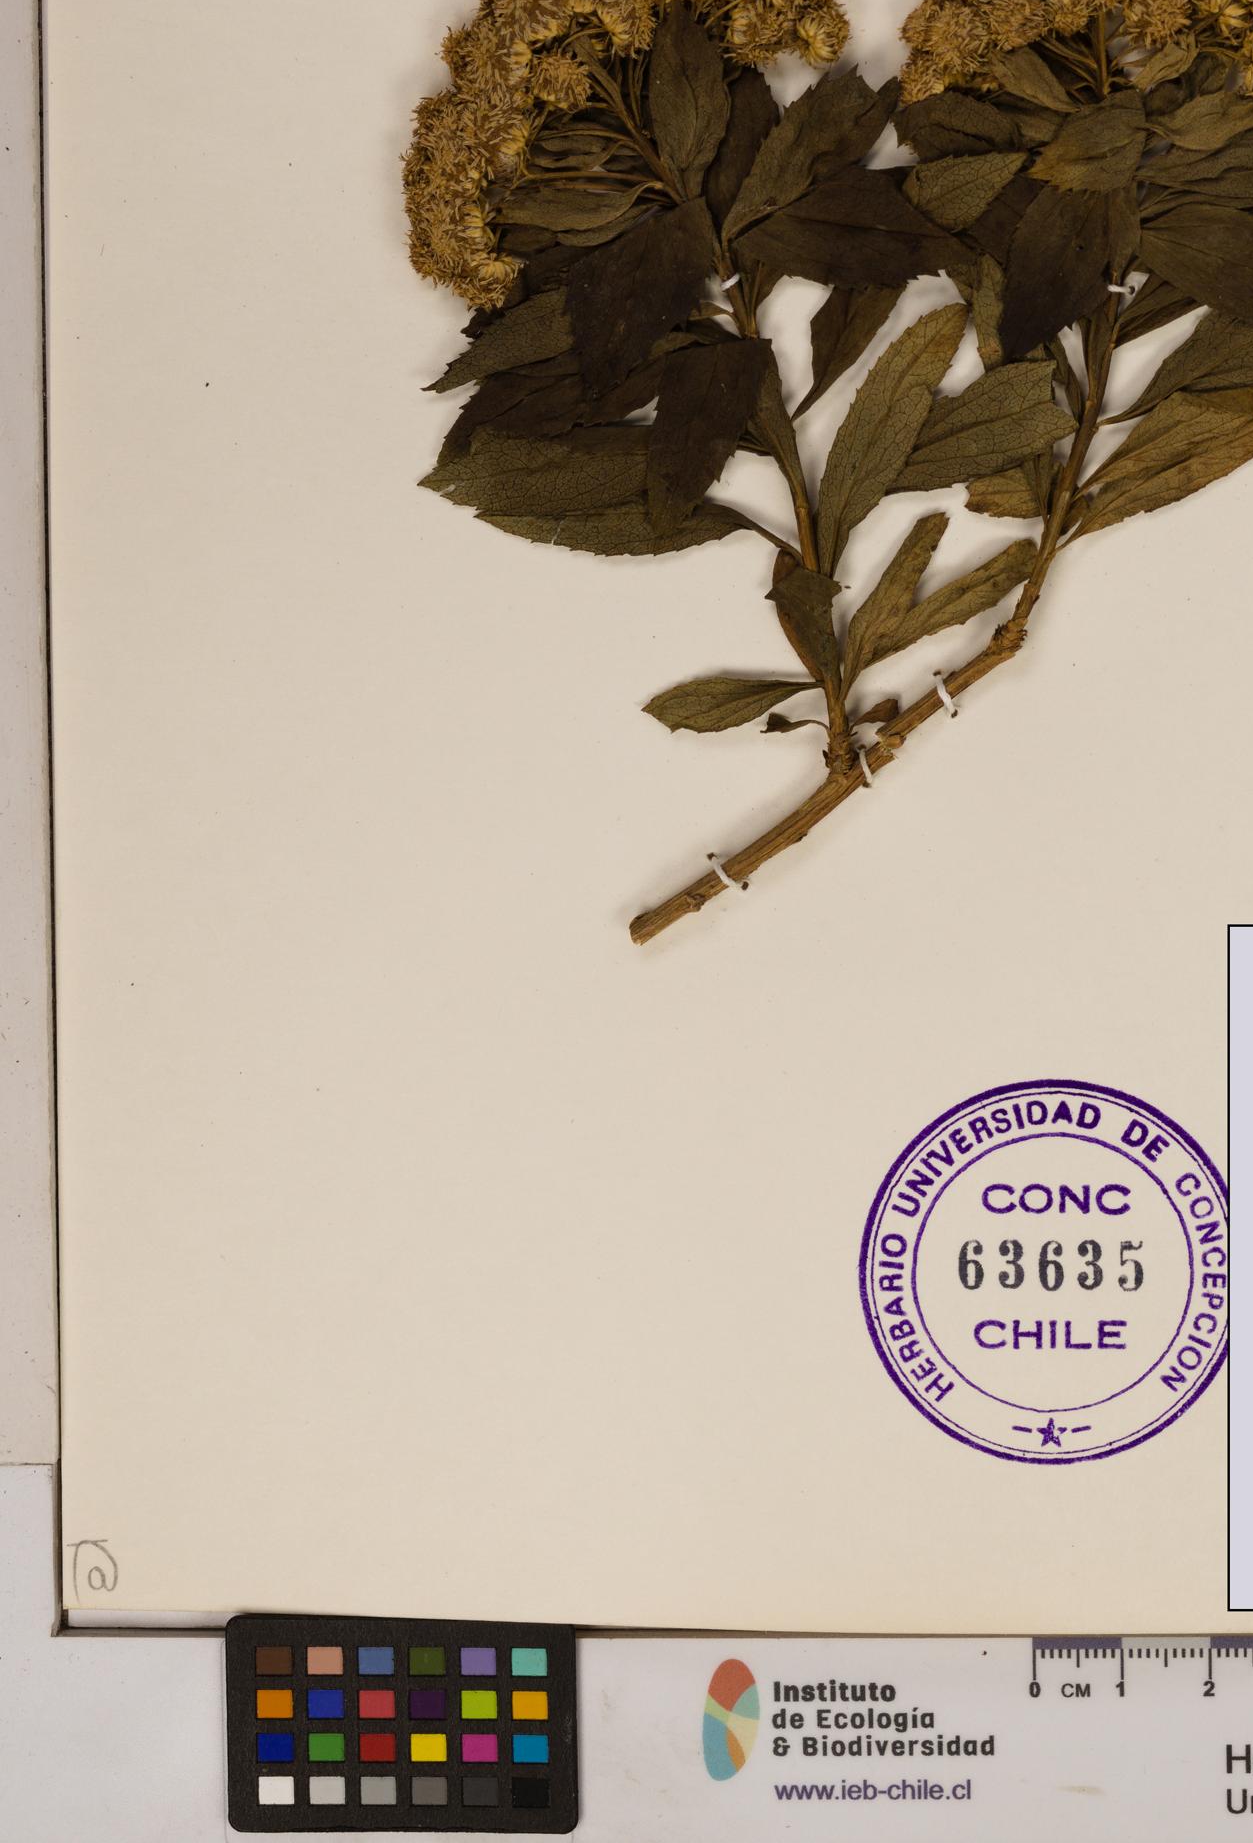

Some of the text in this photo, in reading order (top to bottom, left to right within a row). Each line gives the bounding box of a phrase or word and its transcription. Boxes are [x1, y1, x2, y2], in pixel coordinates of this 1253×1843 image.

[981, 1183, 1132, 1216] CONC
[879, 1100, 1227, 1402] HERBARIO UNIVERSIDAD DE CONCEPCION
[958, 1239, 1144, 1292] 63635
[973, 1319, 1128, 1350] CHILE
[773, 1678, 897, 1703] Instituto
[1028, 1679, 1042, 1699] 0
[1060, 1682, 1091, 1699] CM
[1115, 1680, 1125, 1698] 1
[1202, 1677, 1216, 1697] 2
[771, 1705, 936, 1733] de Ecología
[772, 1733, 996, 1758] & Biodiversidad
[773, 1778, 972, 1801] www.ieb-chile.cl
